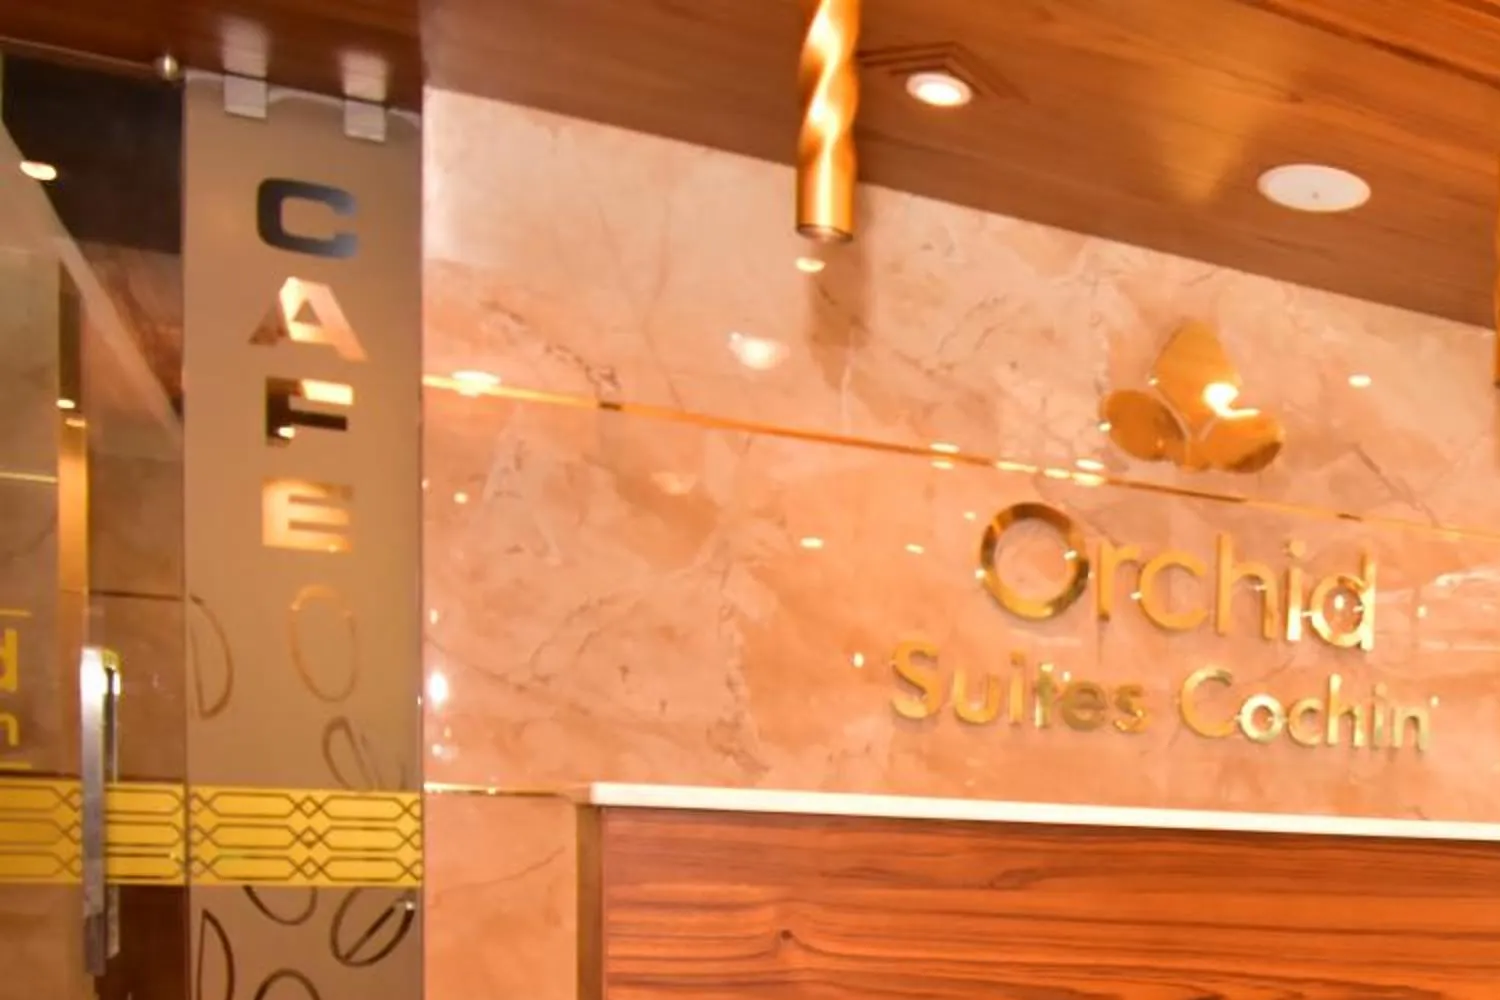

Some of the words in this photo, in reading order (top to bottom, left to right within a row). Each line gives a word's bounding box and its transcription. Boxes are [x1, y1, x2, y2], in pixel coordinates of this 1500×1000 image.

[248, 177, 367, 553] CAFE
[979, 501, 1376, 651] Orchid
[890, 641, 1148, 735] Suites
[1180, 667, 1430, 752] Cochin
